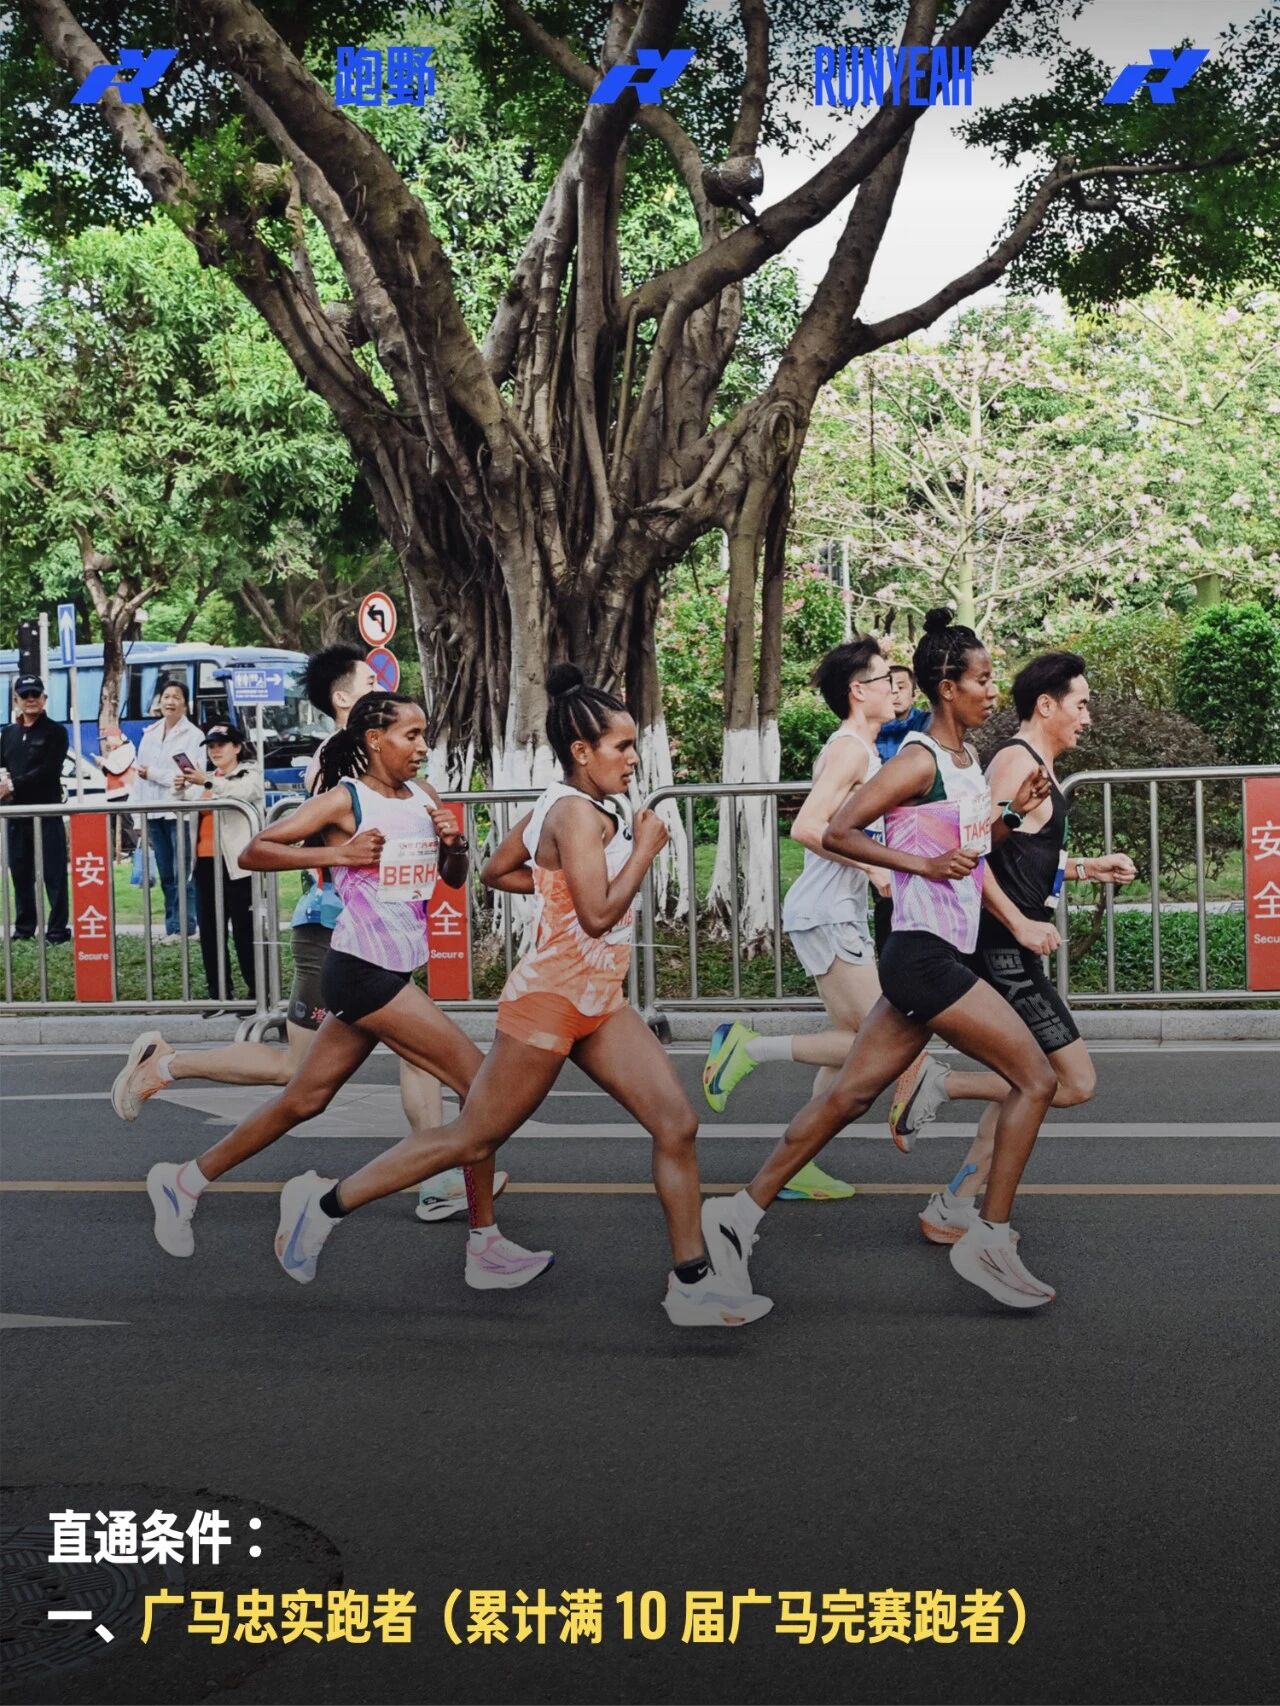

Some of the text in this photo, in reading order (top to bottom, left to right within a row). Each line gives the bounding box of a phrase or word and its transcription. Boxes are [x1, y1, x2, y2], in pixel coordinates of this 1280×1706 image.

[76, 851, 107, 938] 安全
[430, 901, 463, 935] 全
[1253, 933, 1280, 944] Secu
[78, 951, 110, 961] Secure
[430, 949, 465, 959] Secure
